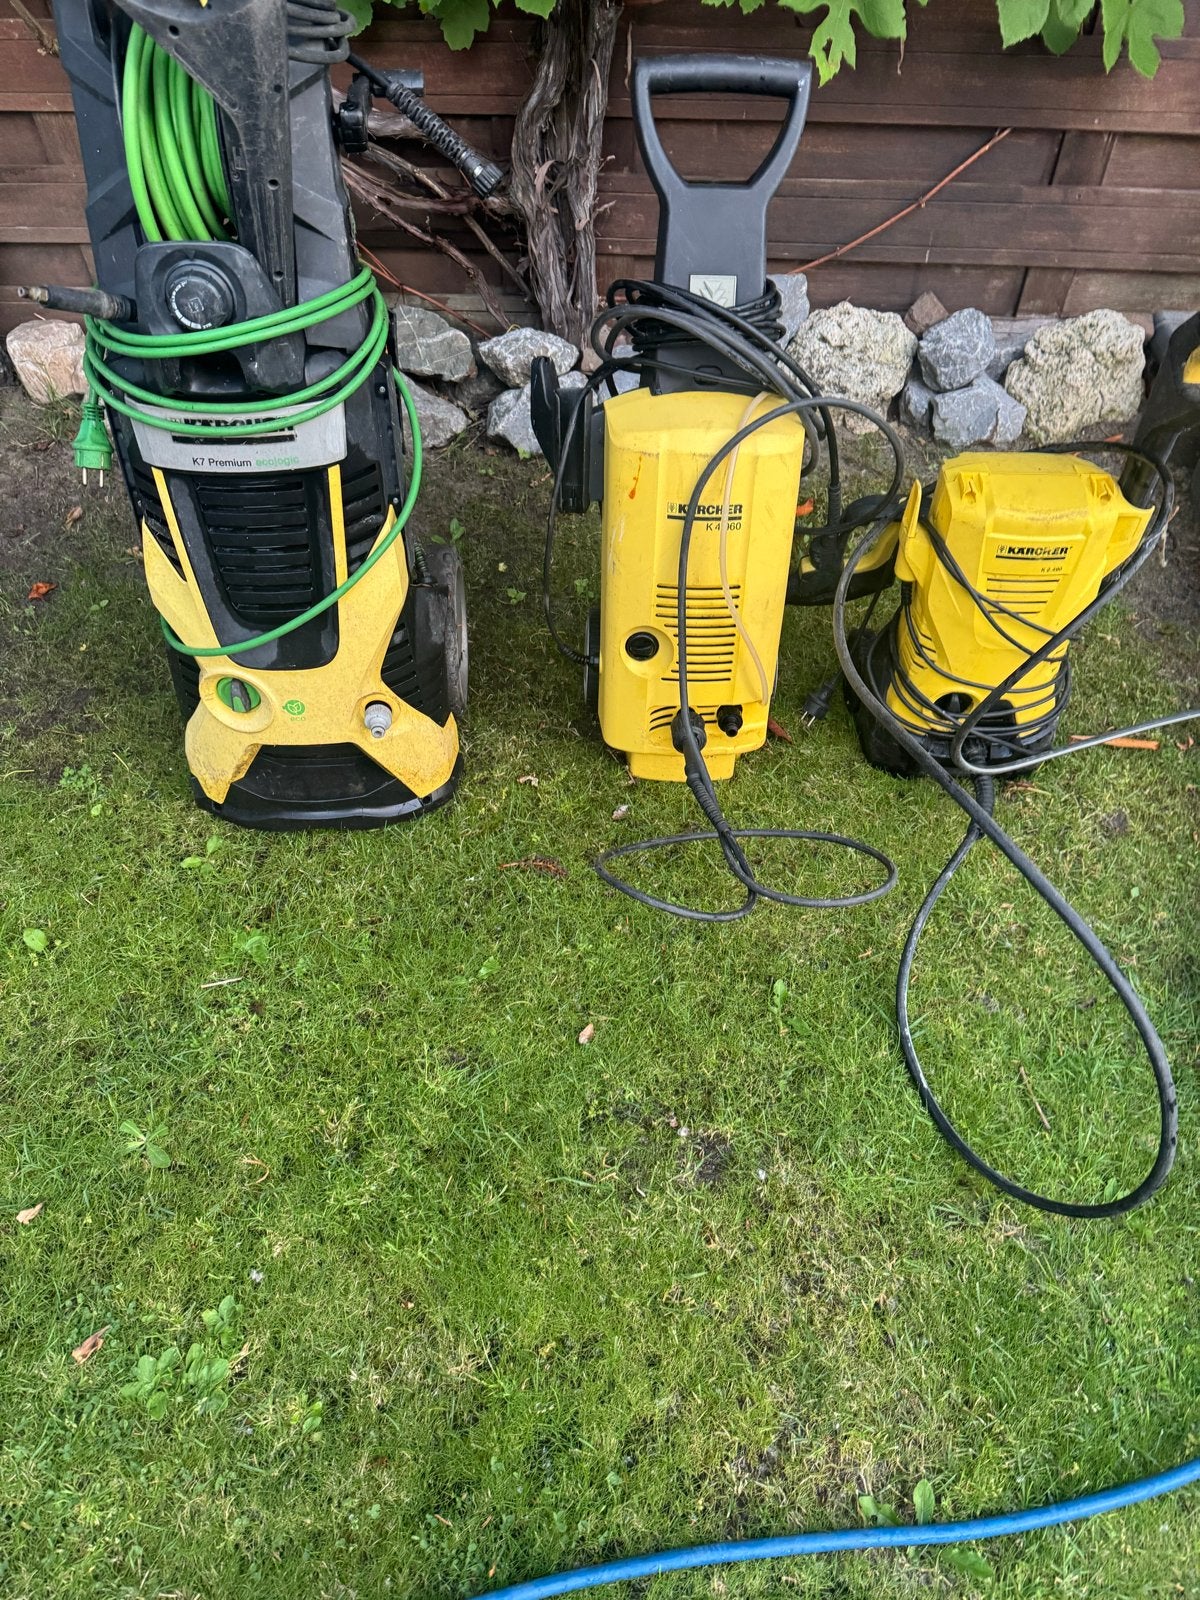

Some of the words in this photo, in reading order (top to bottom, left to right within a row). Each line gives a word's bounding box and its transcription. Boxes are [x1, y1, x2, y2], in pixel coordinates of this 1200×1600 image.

[192, 457, 205, 466] K7
[208, 458, 252, 467] Premium
[256, 455, 300, 468] ecologic
[678, 503, 743, 515] KRCHER
[706, 522, 713, 531] K
